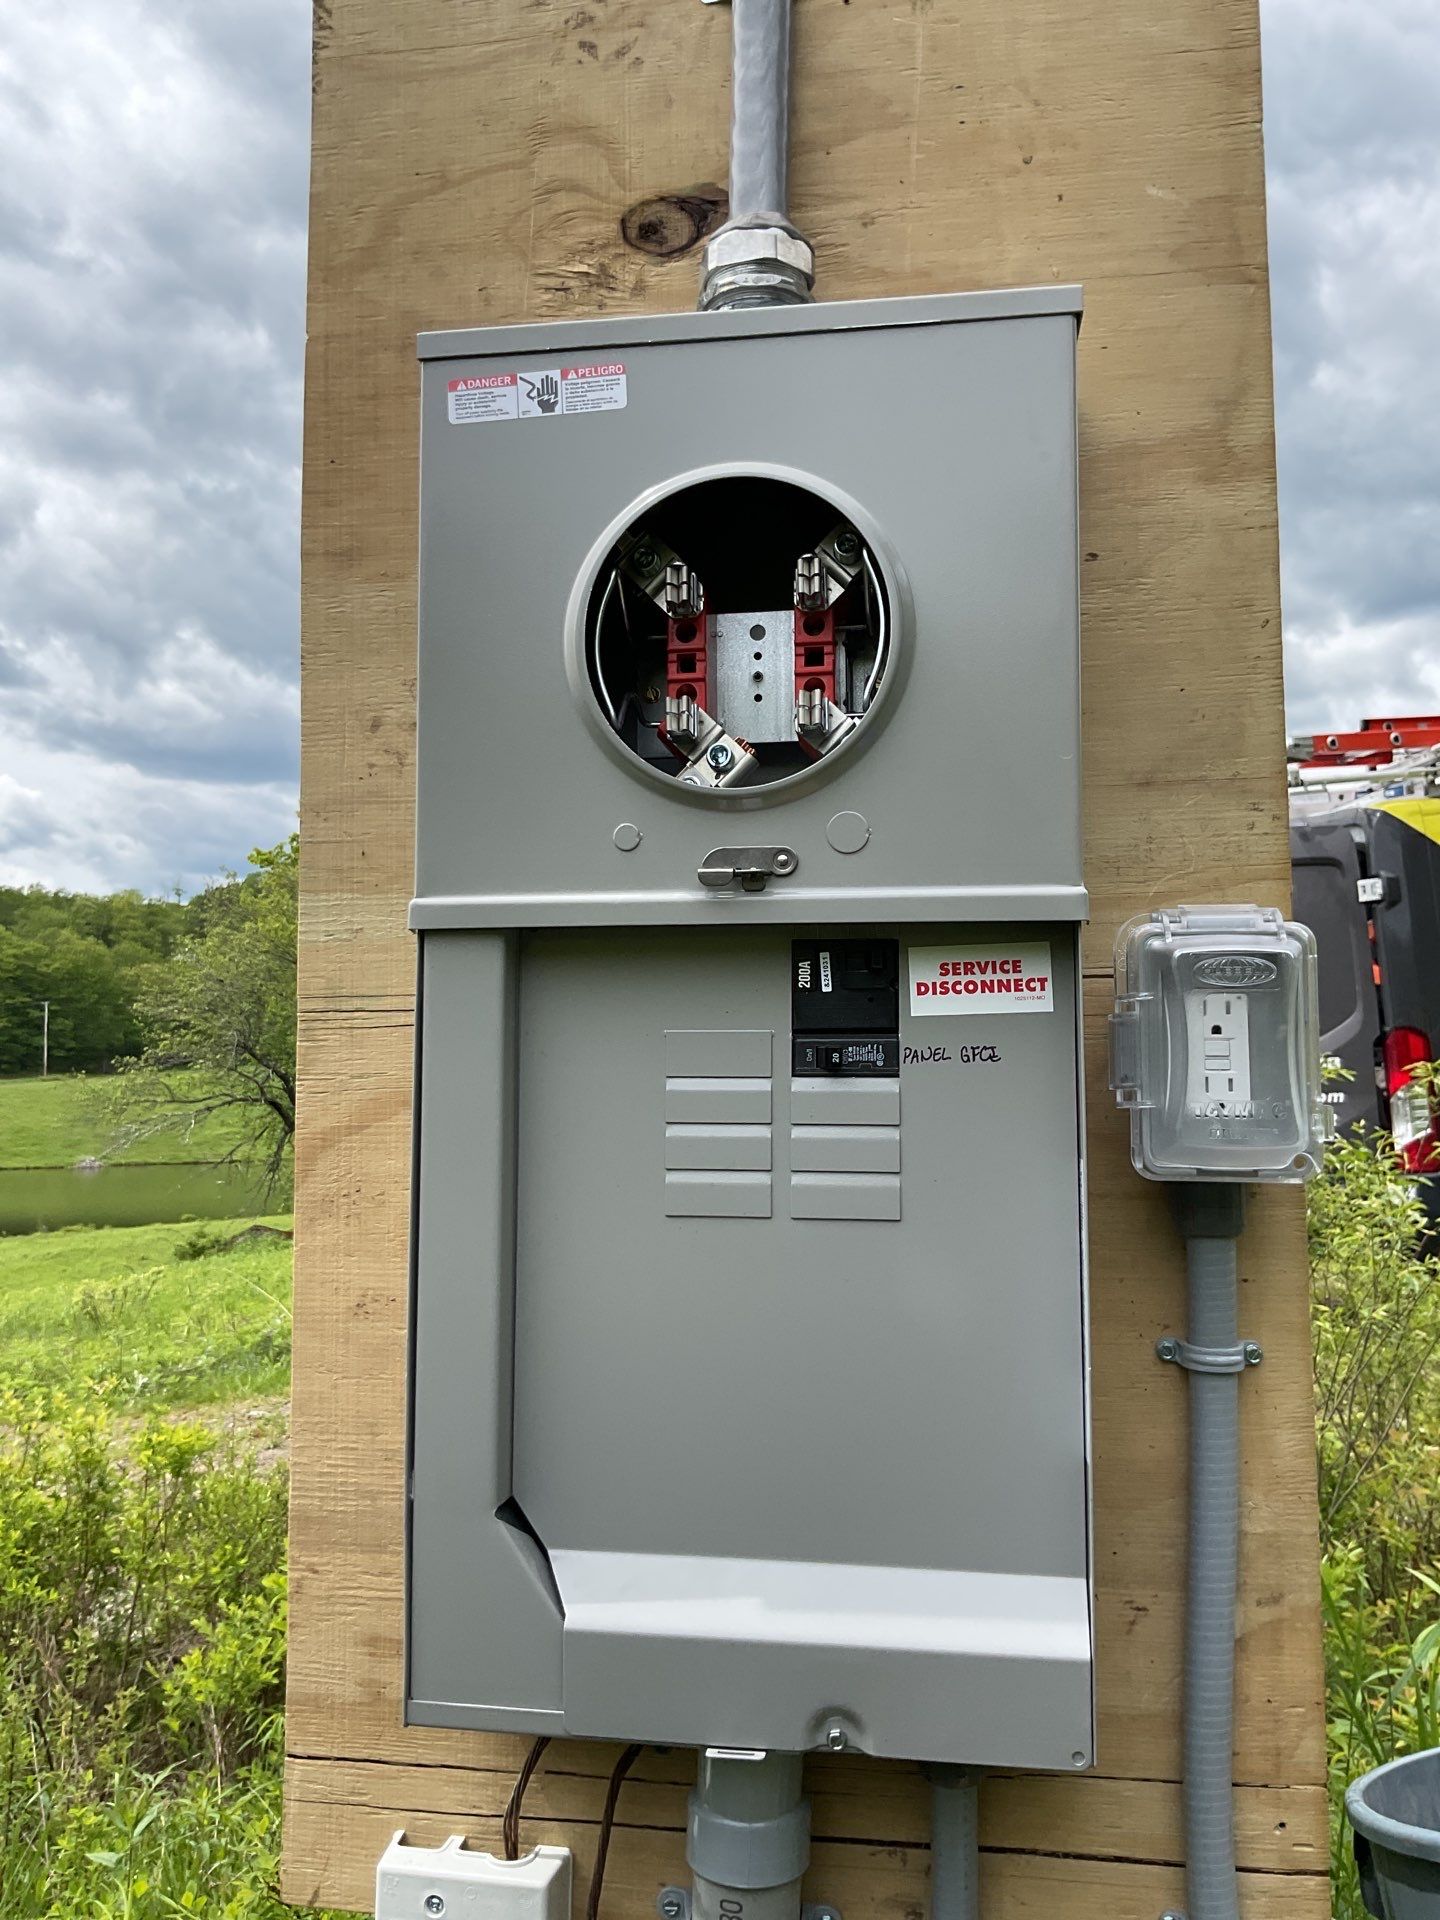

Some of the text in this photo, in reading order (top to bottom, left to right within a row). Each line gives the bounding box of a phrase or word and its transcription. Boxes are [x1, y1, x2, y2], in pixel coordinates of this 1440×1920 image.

[578, 364, 624, 378] PELIGRO
[467, 377, 512, 389] DANGER
[798, 961, 811, 988] 200A
[938, 960, 1022, 977] SERVICE
[915, 977, 1048, 996] DISCONNECT
[832, 1052, 840, 1063] 20
[903, 1048, 951, 1064] PANEL
